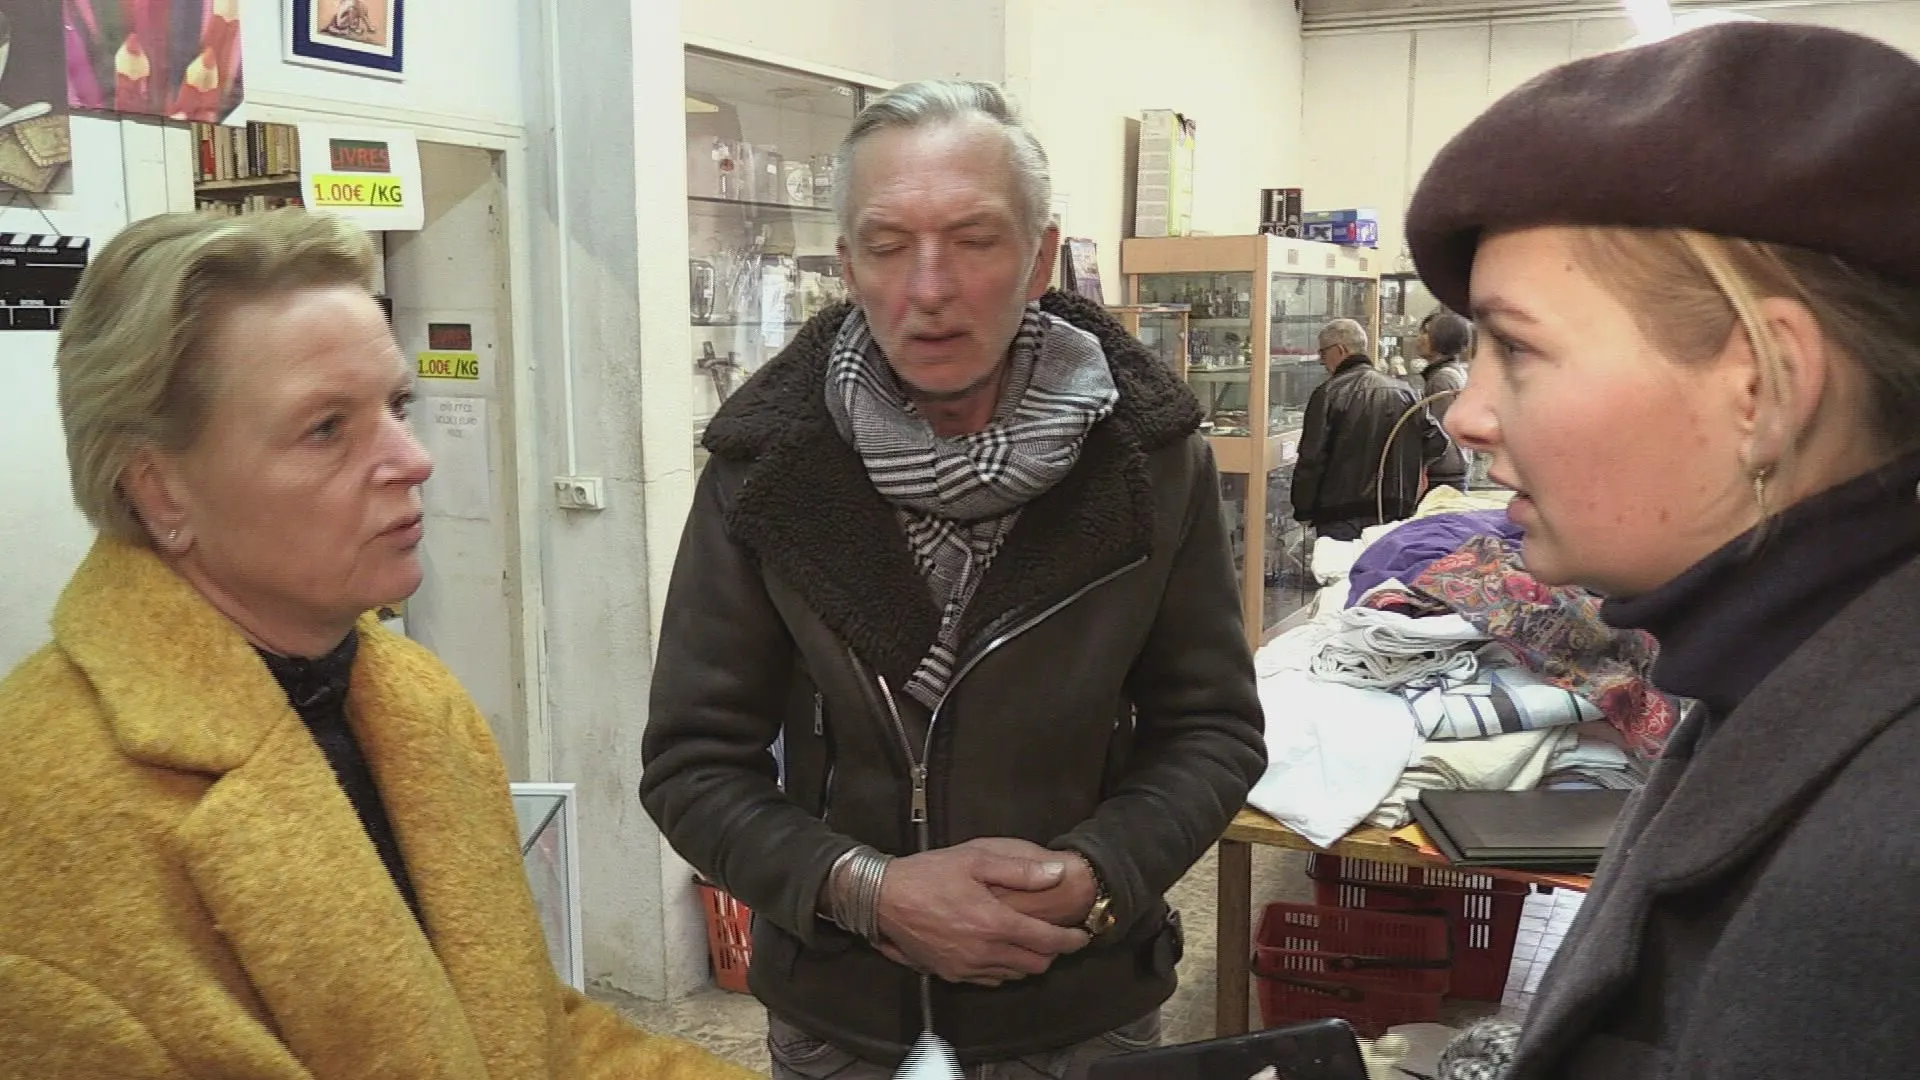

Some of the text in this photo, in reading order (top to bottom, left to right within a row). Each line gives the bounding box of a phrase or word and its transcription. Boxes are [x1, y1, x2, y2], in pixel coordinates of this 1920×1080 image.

[331, 147, 389, 167] LIVRES
[315, 183, 402, 205] 1.00€ /KG
[418, 359, 478, 377] 1.00€ /KG
